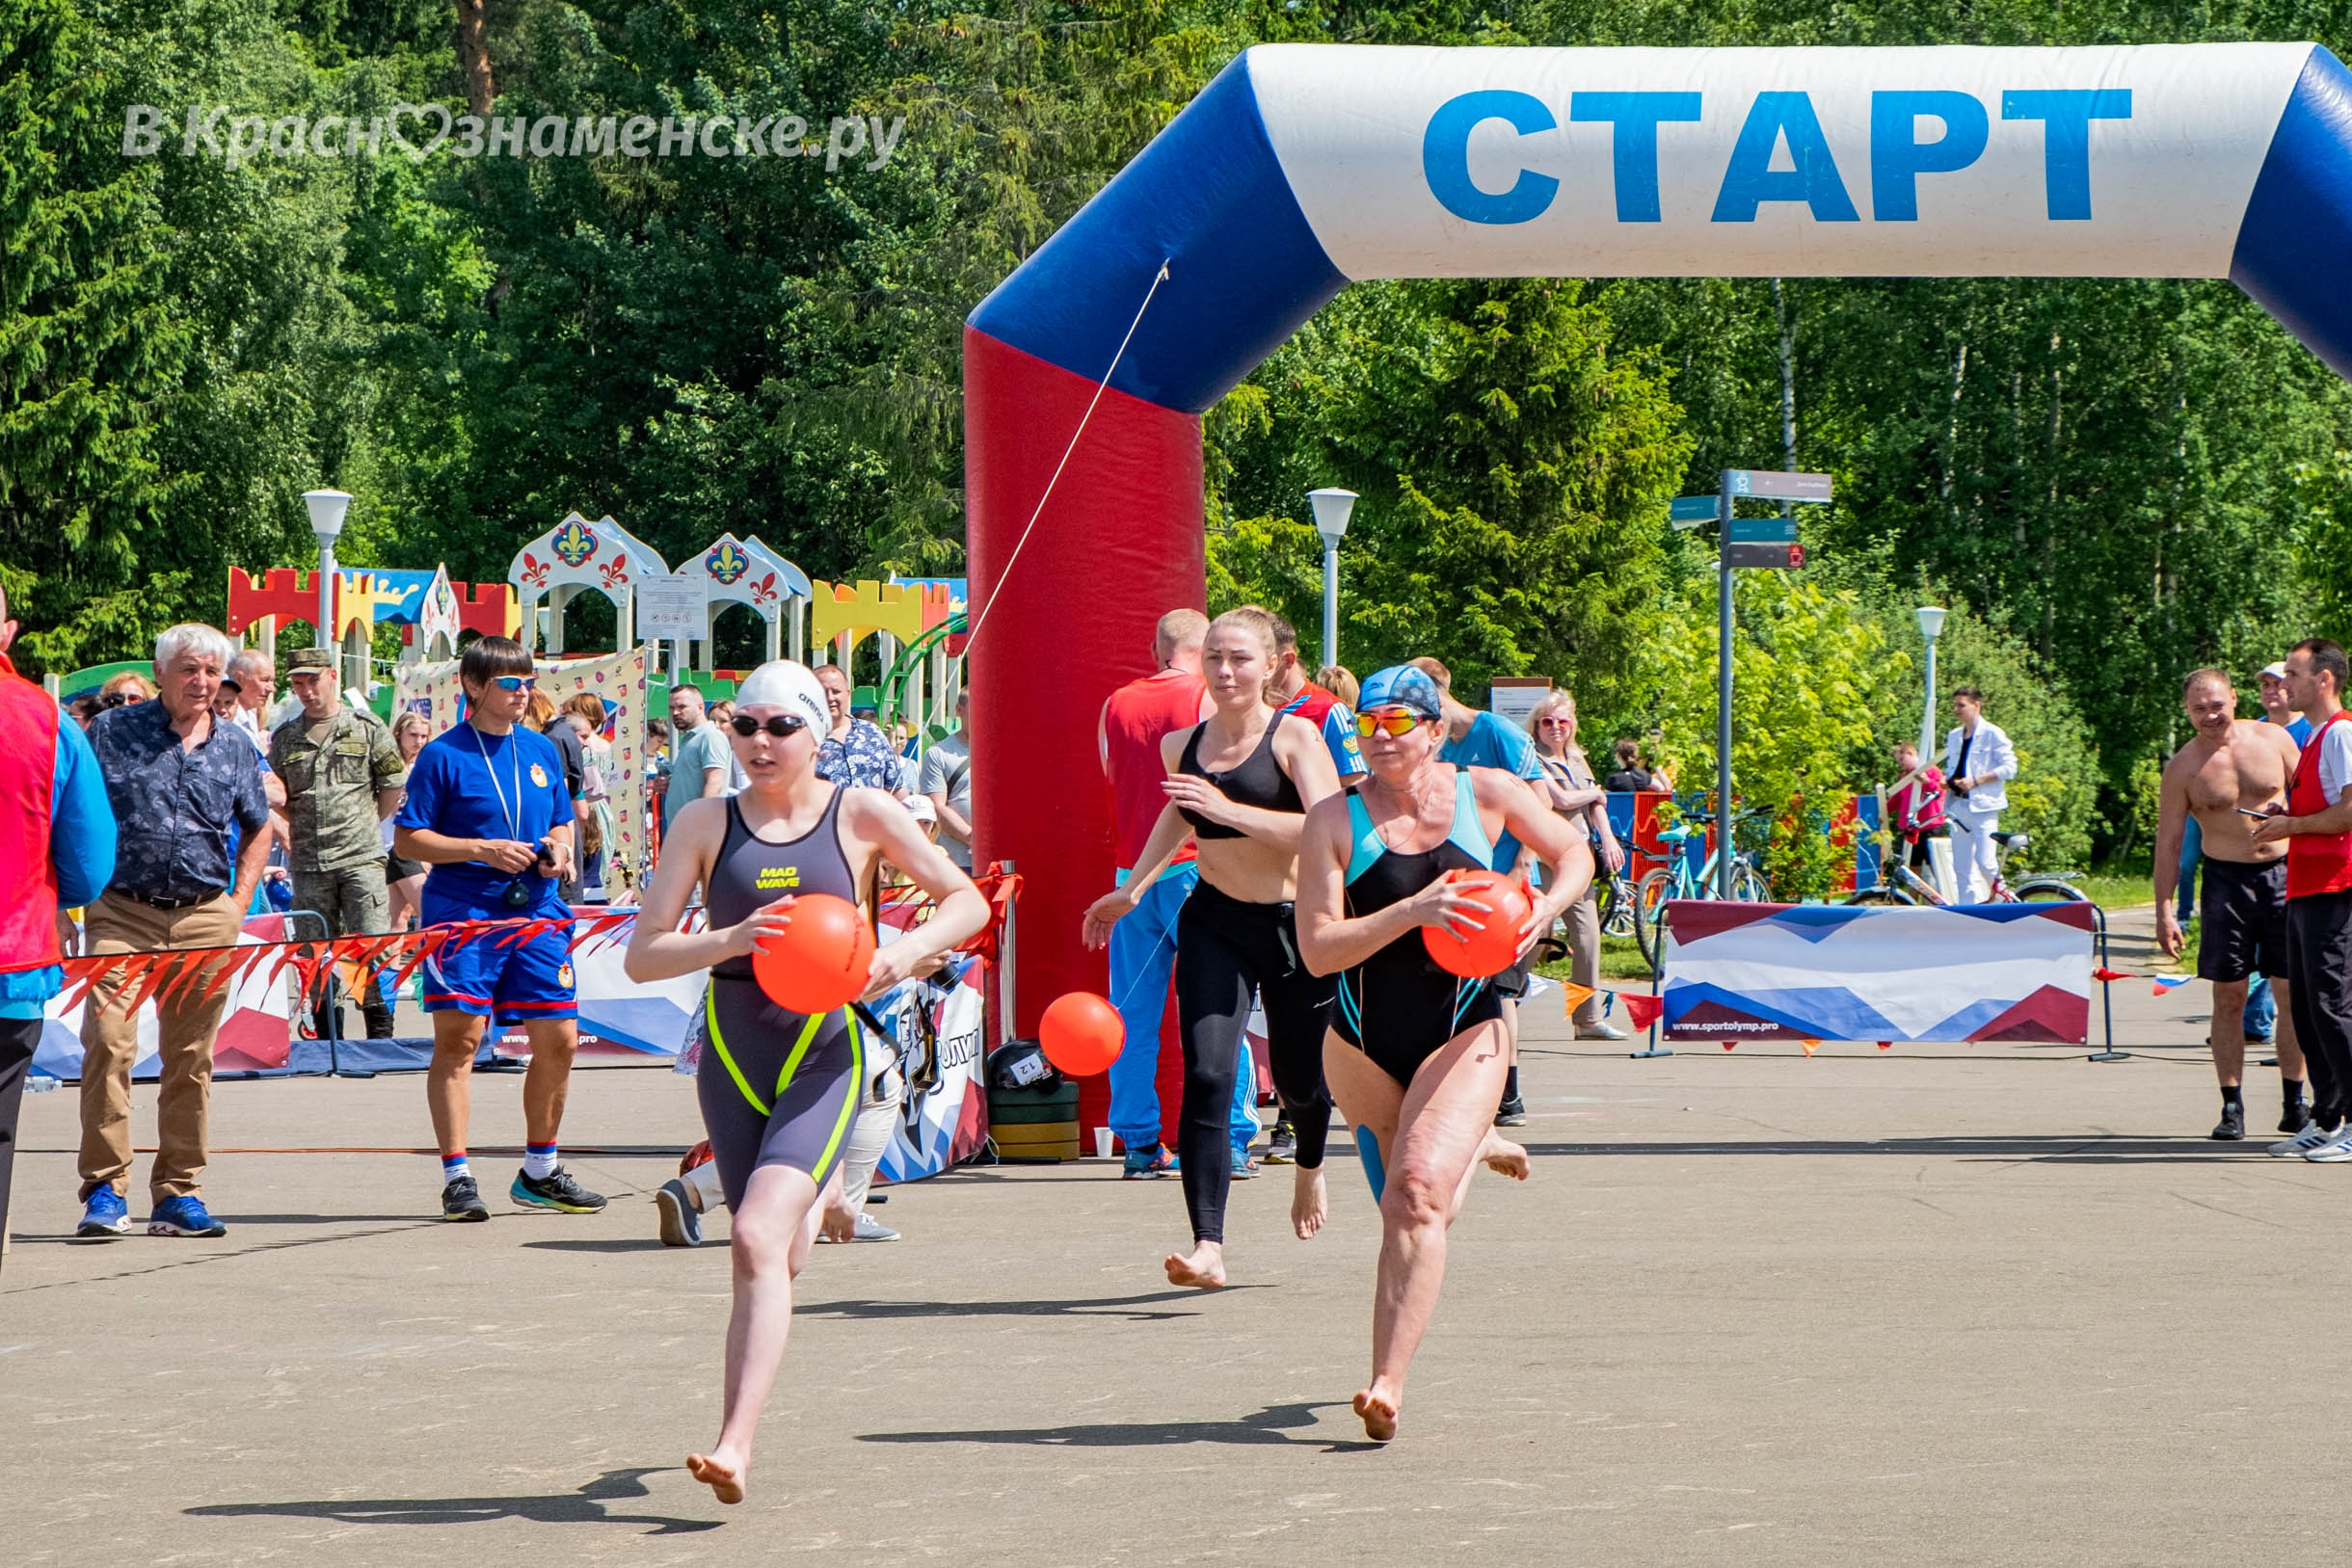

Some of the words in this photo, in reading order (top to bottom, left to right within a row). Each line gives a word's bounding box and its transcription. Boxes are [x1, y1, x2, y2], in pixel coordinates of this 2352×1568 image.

[1423, 90, 2132, 224] СТАРТ
[798, 693, 823, 723] arena
[760, 866, 796, 877] MAD
[756, 877, 800, 889] WAVE
[1672, 1022, 1778, 1032] www.sportolymp.pro
